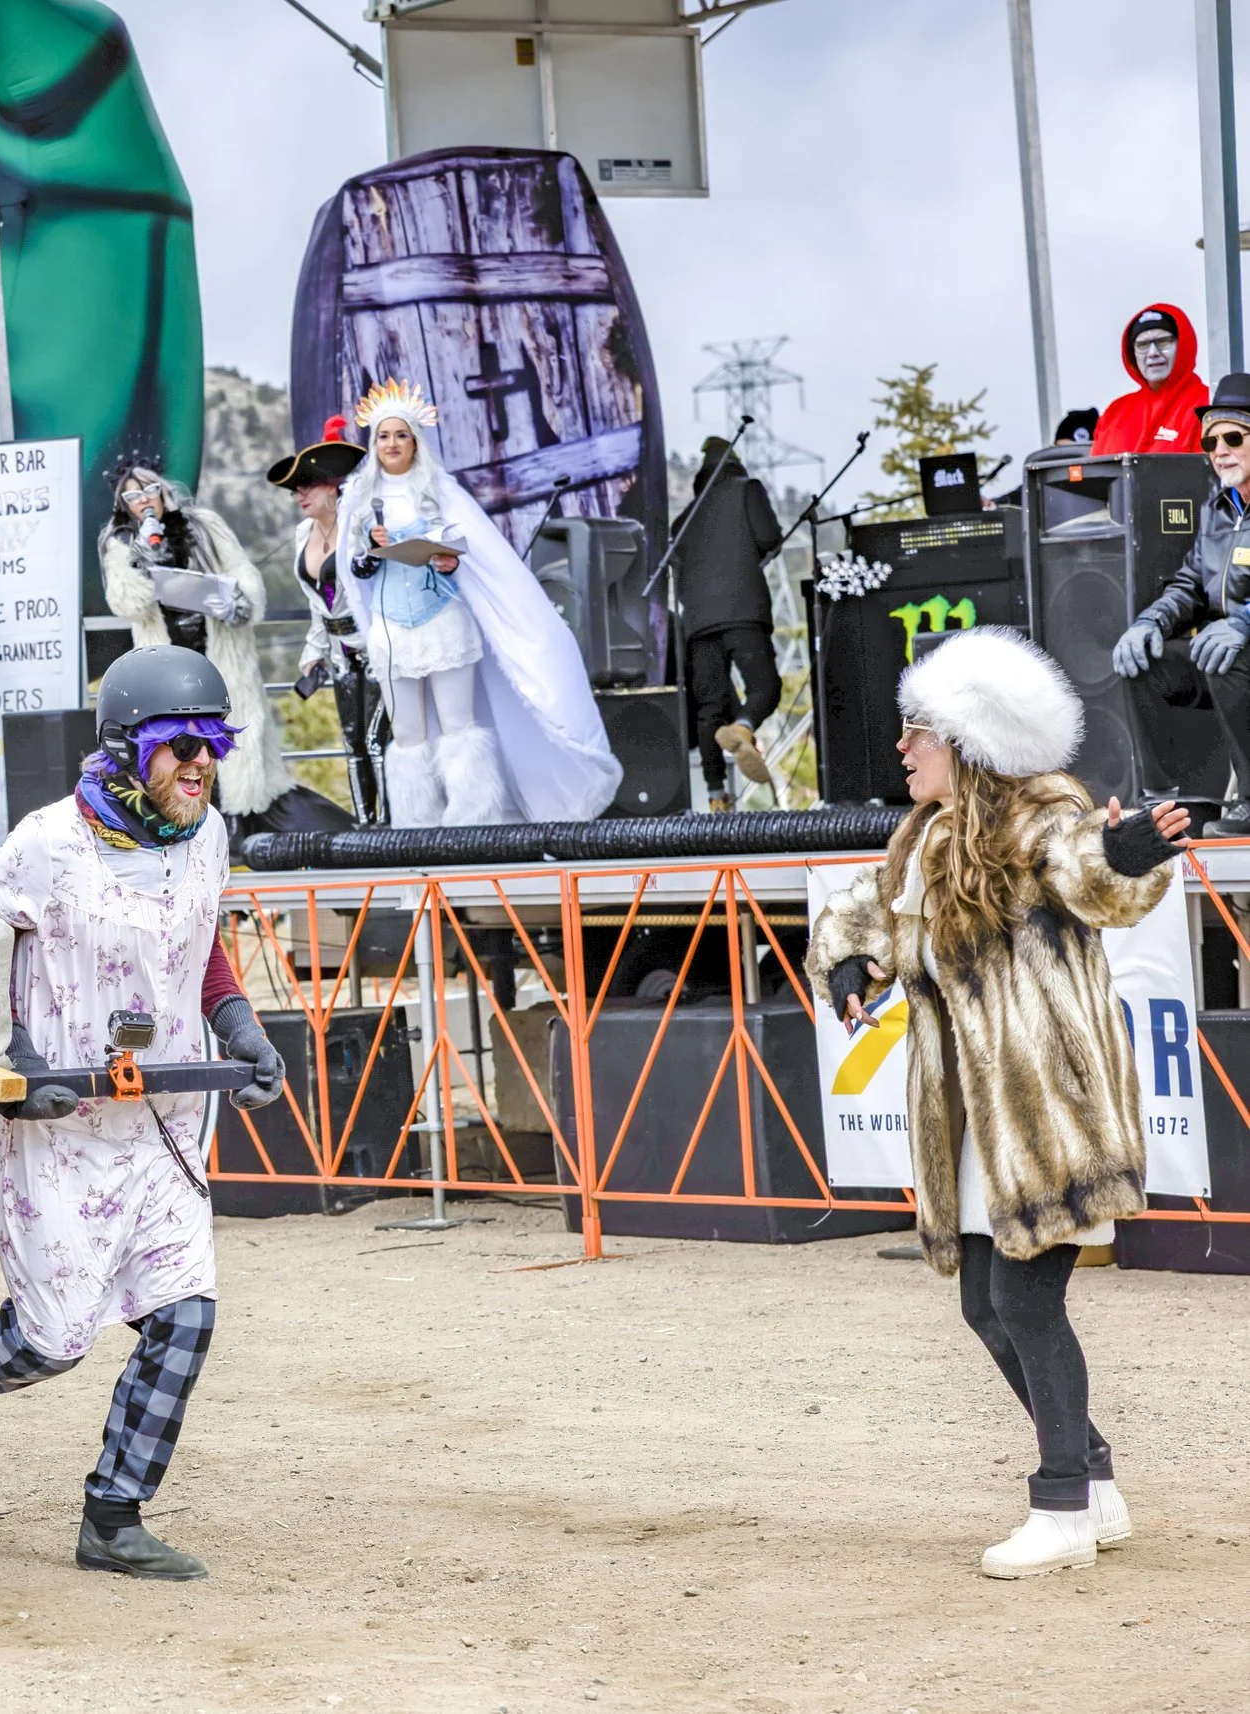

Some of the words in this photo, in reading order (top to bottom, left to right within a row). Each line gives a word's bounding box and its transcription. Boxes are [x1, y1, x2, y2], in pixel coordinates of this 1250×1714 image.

[16, 450, 46, 473] BAR
[2, 557, 27, 575] MS
[15, 597, 61, 622] PROD.
[839, 1114, 864, 1131] THE
[870, 1114, 909, 1131] WORL
[1149, 1116, 1189, 1136] 1972
